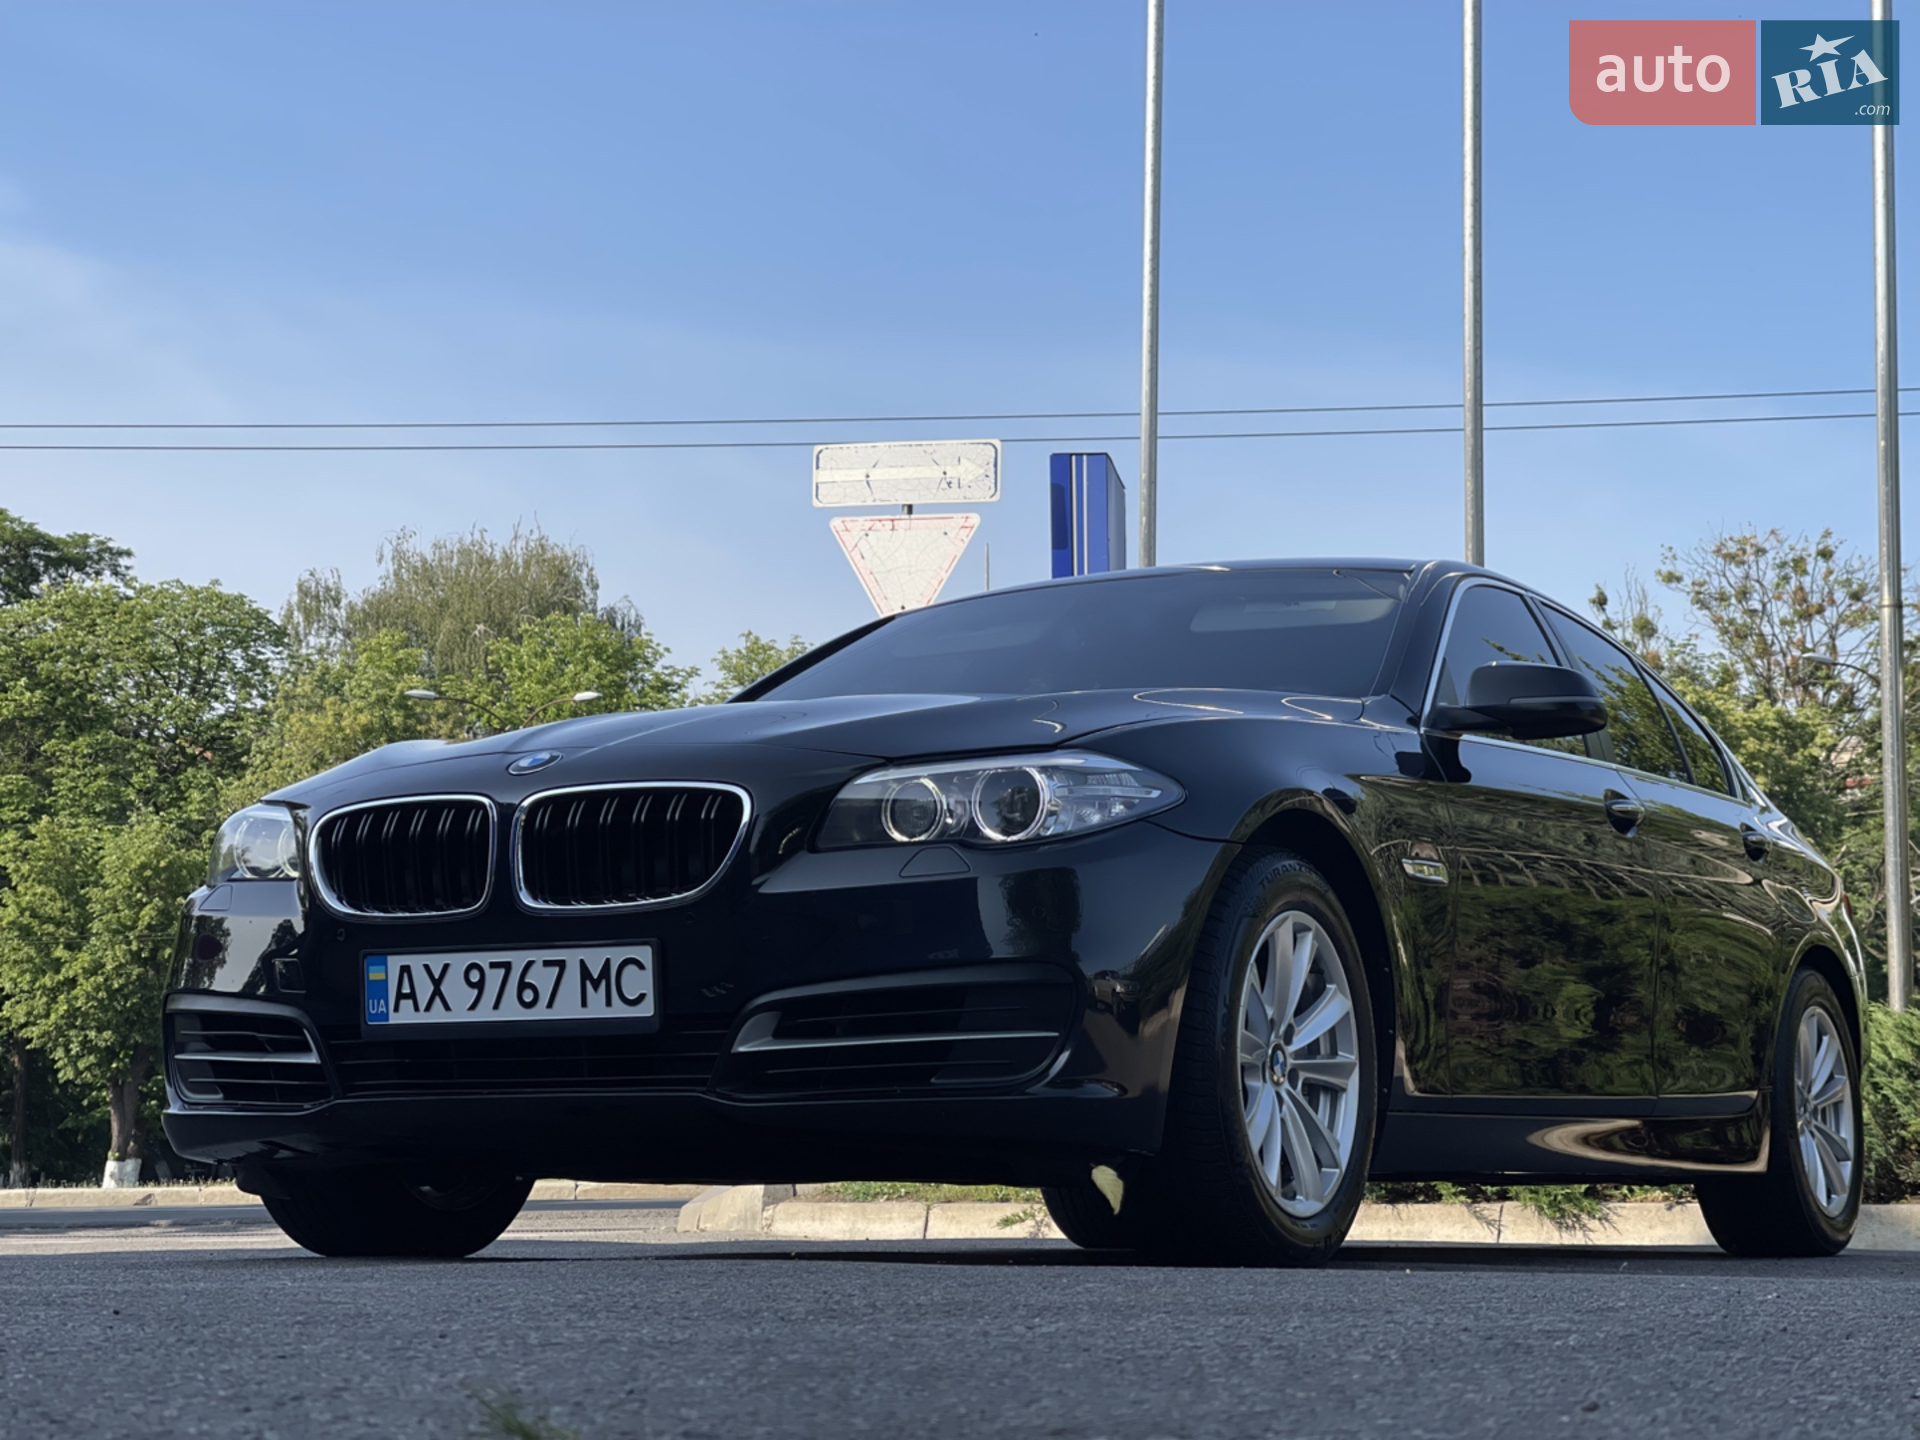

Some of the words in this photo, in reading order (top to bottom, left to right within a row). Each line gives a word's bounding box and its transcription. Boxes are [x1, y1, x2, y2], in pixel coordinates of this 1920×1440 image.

[392, 962, 453, 1013] AX
[462, 958, 567, 1012] 9767
[578, 955, 648, 1009] MC
[368, 998, 388, 1014] UA
